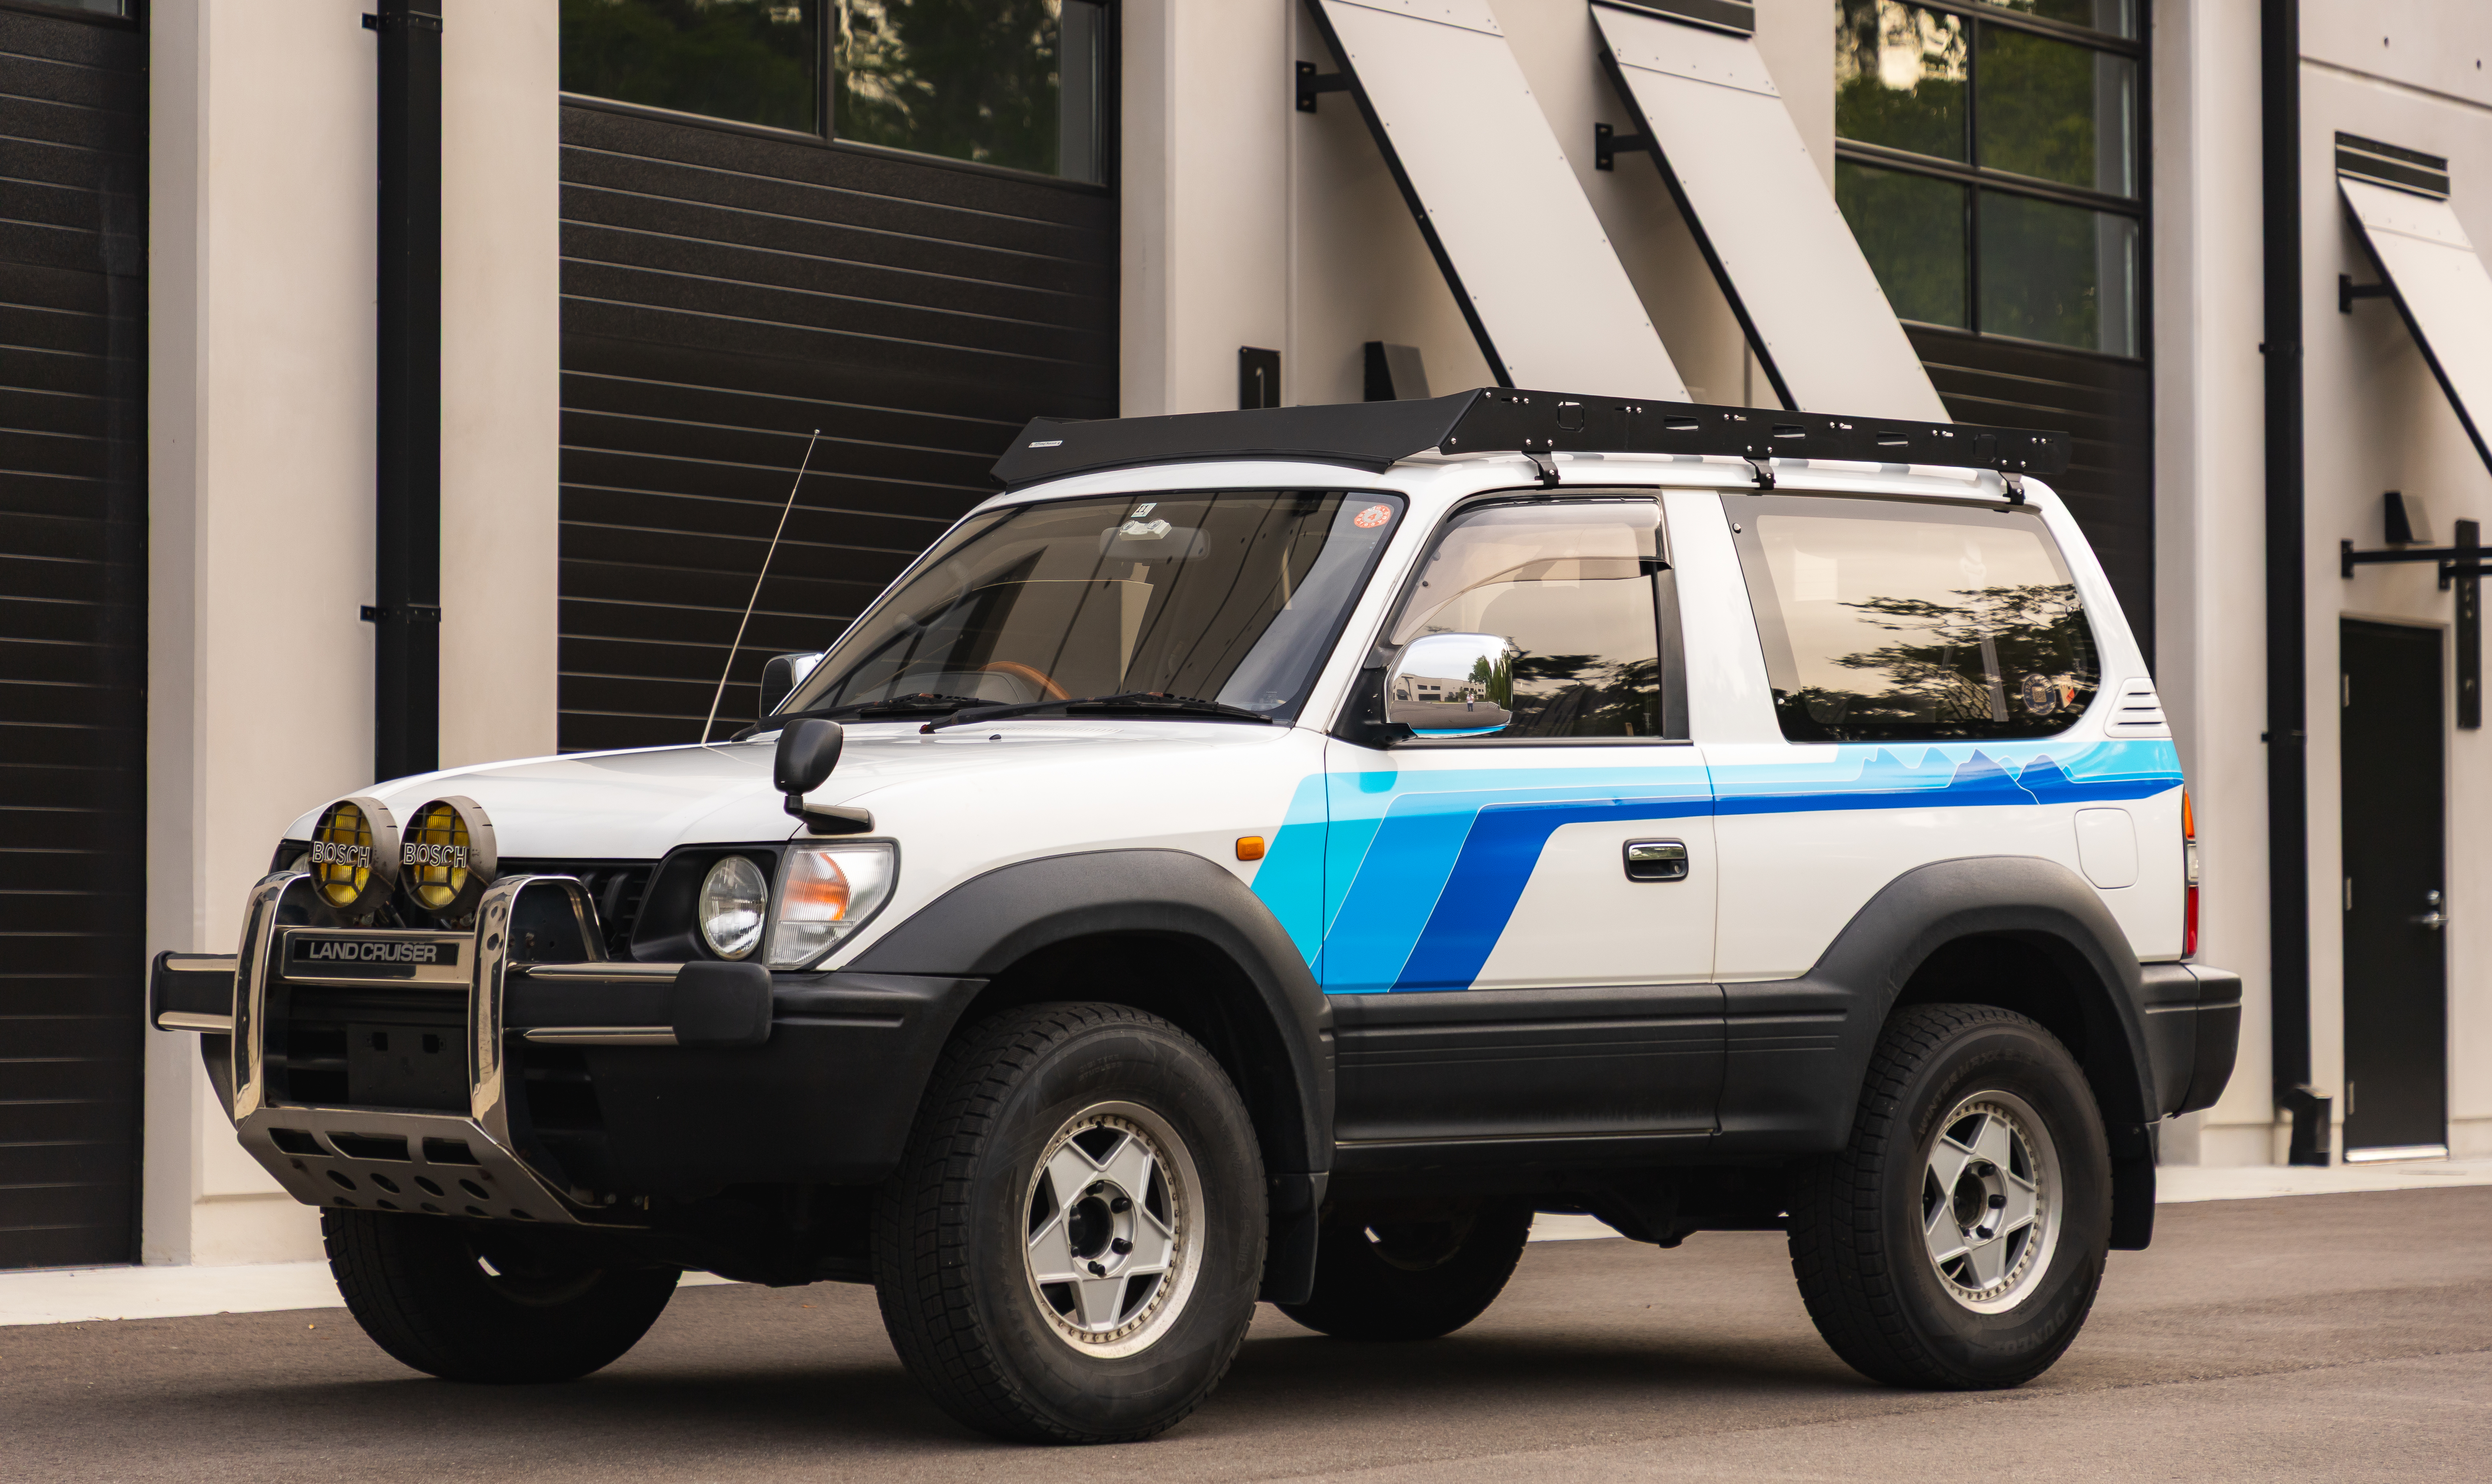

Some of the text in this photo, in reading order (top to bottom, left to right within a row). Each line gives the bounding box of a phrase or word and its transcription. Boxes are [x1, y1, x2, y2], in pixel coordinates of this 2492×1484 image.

[1135, 504, 1149, 513] 11
[312, 841, 370, 867] BOSCH
[403, 843, 467, 868] BOSCH
[310, 942, 436, 962] LAND CRUISER
[1097, 1054, 1119, 1064] TYRE
[1078, 1061, 1124, 1082] STUDLESS
[1919, 1070, 1958, 1135] WINTER
[1958, 1049, 2000, 1077] MAXX
